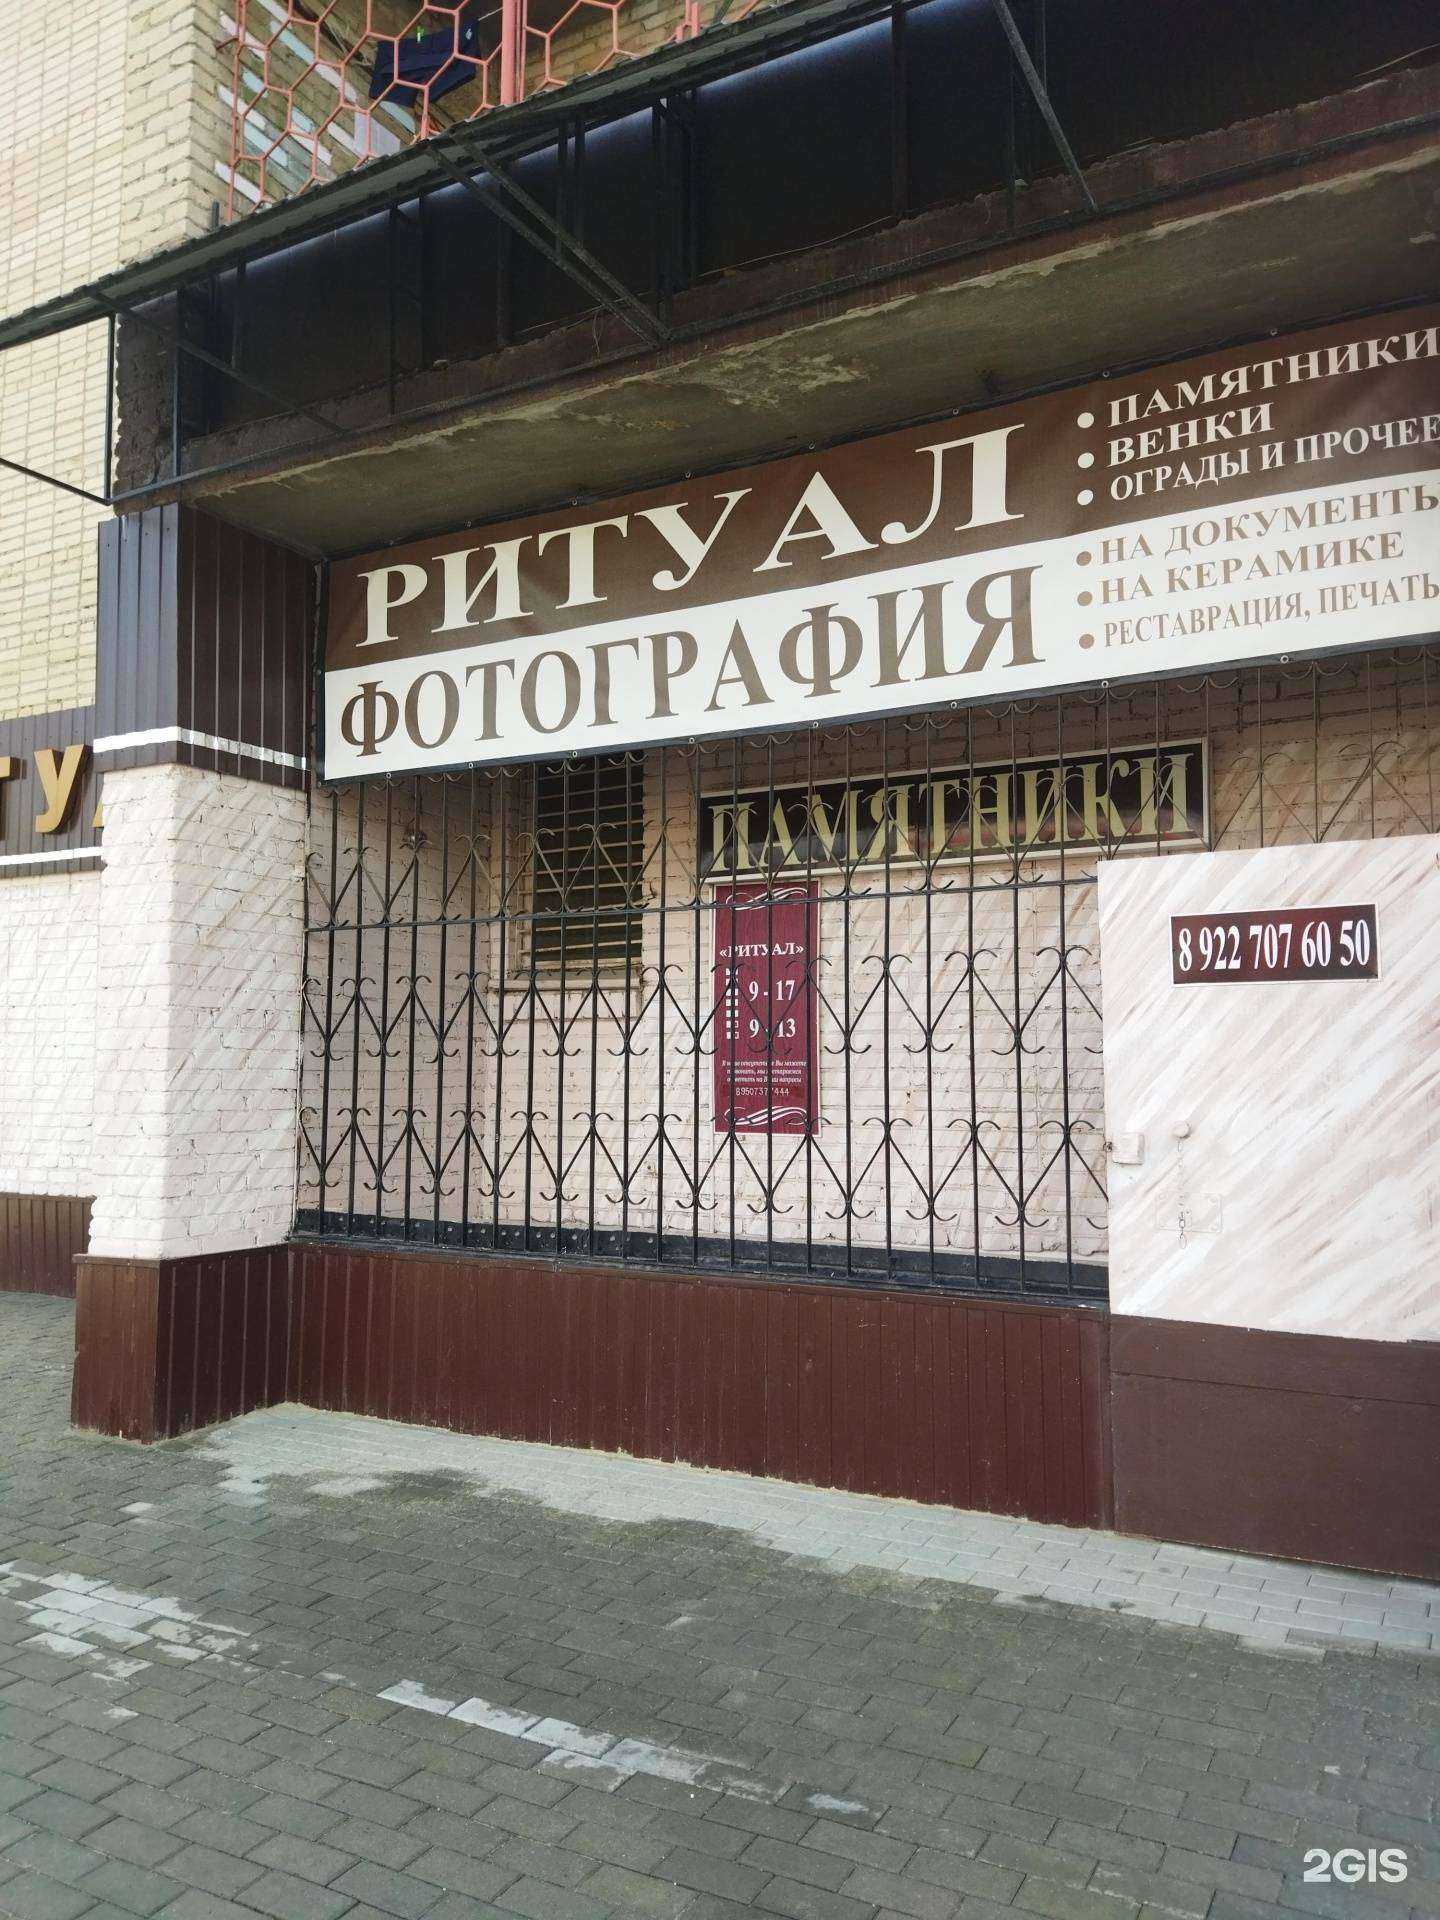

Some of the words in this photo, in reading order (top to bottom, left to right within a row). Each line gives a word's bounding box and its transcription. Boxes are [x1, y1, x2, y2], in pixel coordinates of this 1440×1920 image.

[1107, 326, 1440, 427] ПАМЯТНИКИ
[1107, 402, 1275, 467] ВЕНКИ
[1110, 448, 1250, 501] ОГРАДЫ
[1259, 441, 1285, 471] И
[1293, 413, 1440, 464] ПРОЧЕЕ
[355, 423, 1025, 647] РИТУАЛ
[1099, 533, 1153, 565] НА
[1099, 573, 1154, 604] НА
[1167, 530, 1405, 593] КЕРАМИКЕ
[1104, 592, 1311, 647] РЕСТАВРАЦИЯ,
[340, 565, 1046, 757] ФОТОГРАФИЯ
[707, 753, 1194, 872] ПАМЯТНИКИ
[1179, 928, 1192, 971] 8
[1200, 925, 1242, 970] 922
[1249, 923, 1292, 969] 707
[1302, 921, 1331, 967] 60
[1340, 919, 1370, 966] 50
[749, 981, 759, 1001] 9
[776, 980, 795, 1001] 17
[749, 1018, 760, 1037] 9
[777, 1018, 796, 1037] 13
